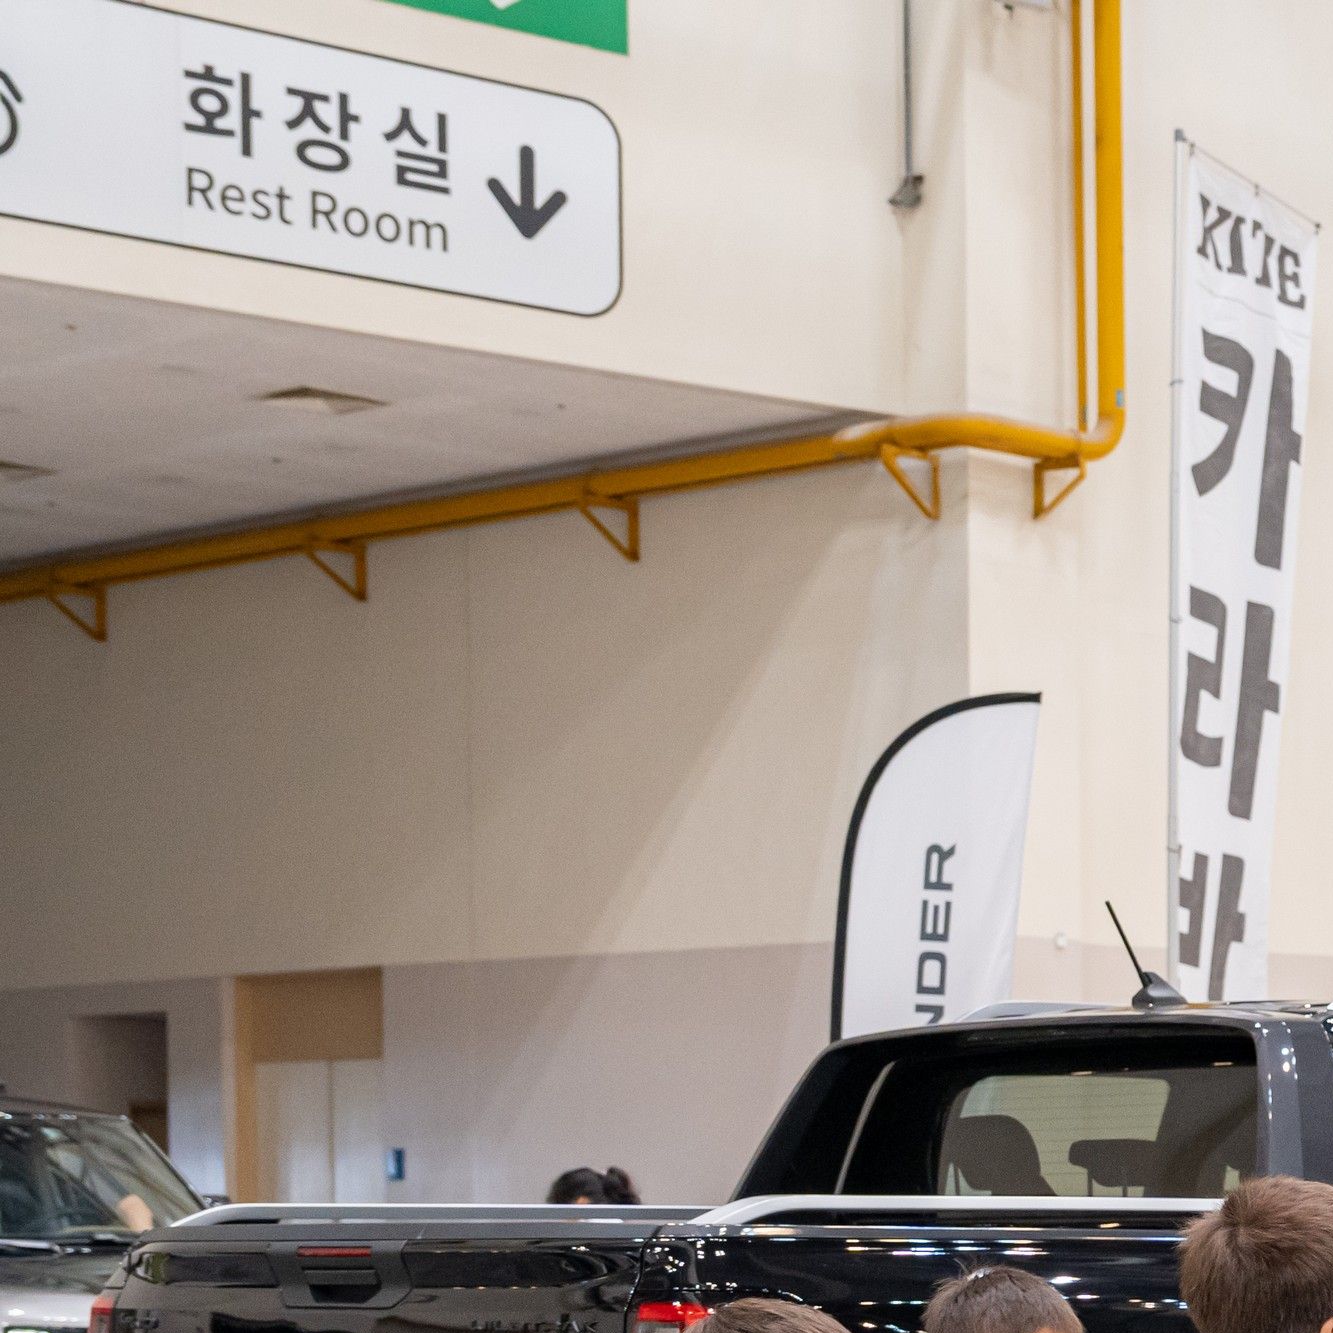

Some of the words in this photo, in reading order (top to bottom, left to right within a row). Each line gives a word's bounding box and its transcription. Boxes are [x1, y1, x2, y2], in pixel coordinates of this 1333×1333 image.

[182, 64, 454, 196] 화장실
[186, 167, 294, 225] Rest
[310, 190, 450, 252] Room
[1195, 193, 1308, 311] KITE
